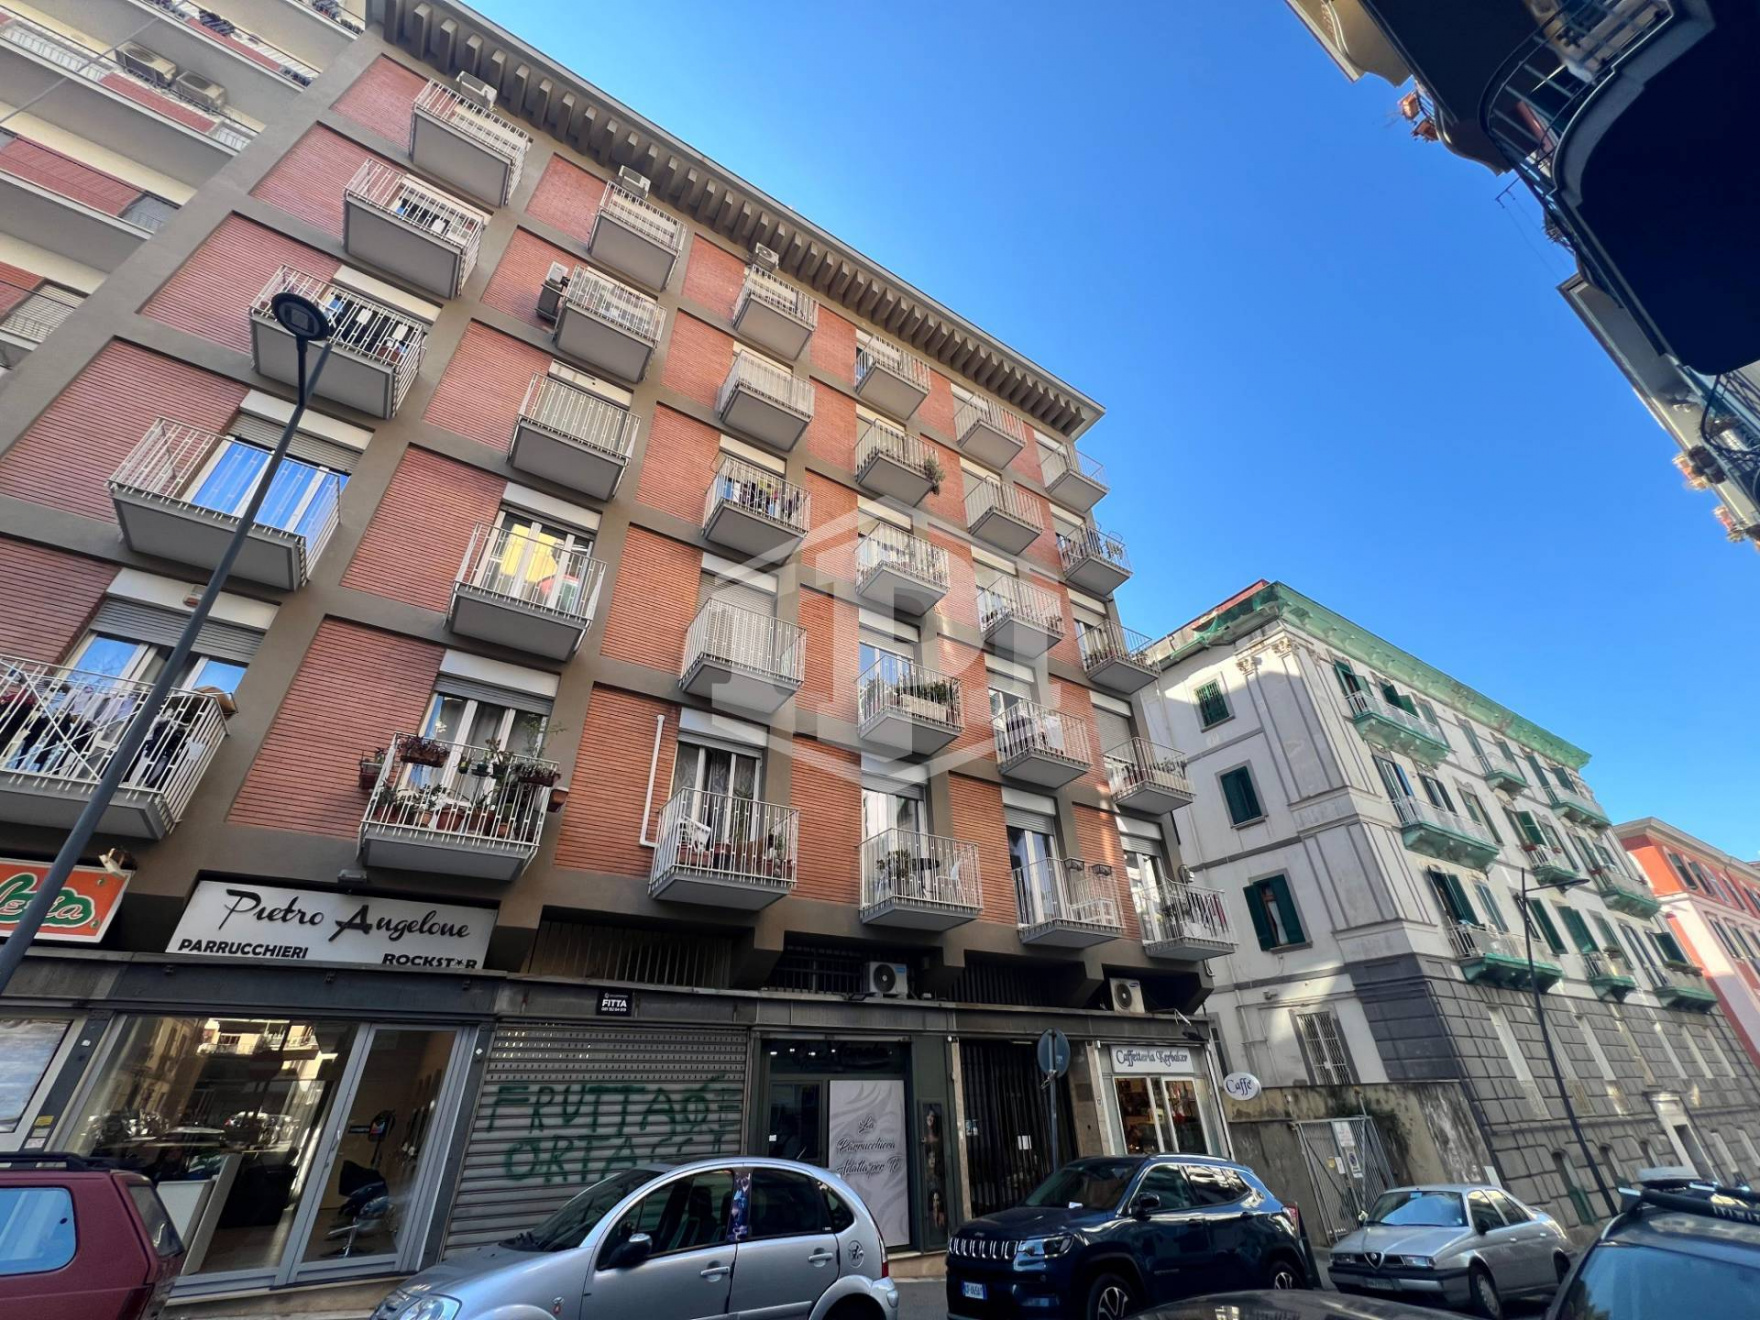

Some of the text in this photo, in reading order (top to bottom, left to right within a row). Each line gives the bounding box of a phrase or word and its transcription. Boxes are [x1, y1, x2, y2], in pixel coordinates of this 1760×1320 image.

[218, 888, 471, 942] Pietro Angelone
[177, 938, 309, 960] PARRUCCHIERI
[601, 999, 627, 1008] FITTA
[486, 1084, 677, 1136] FRUTTA
